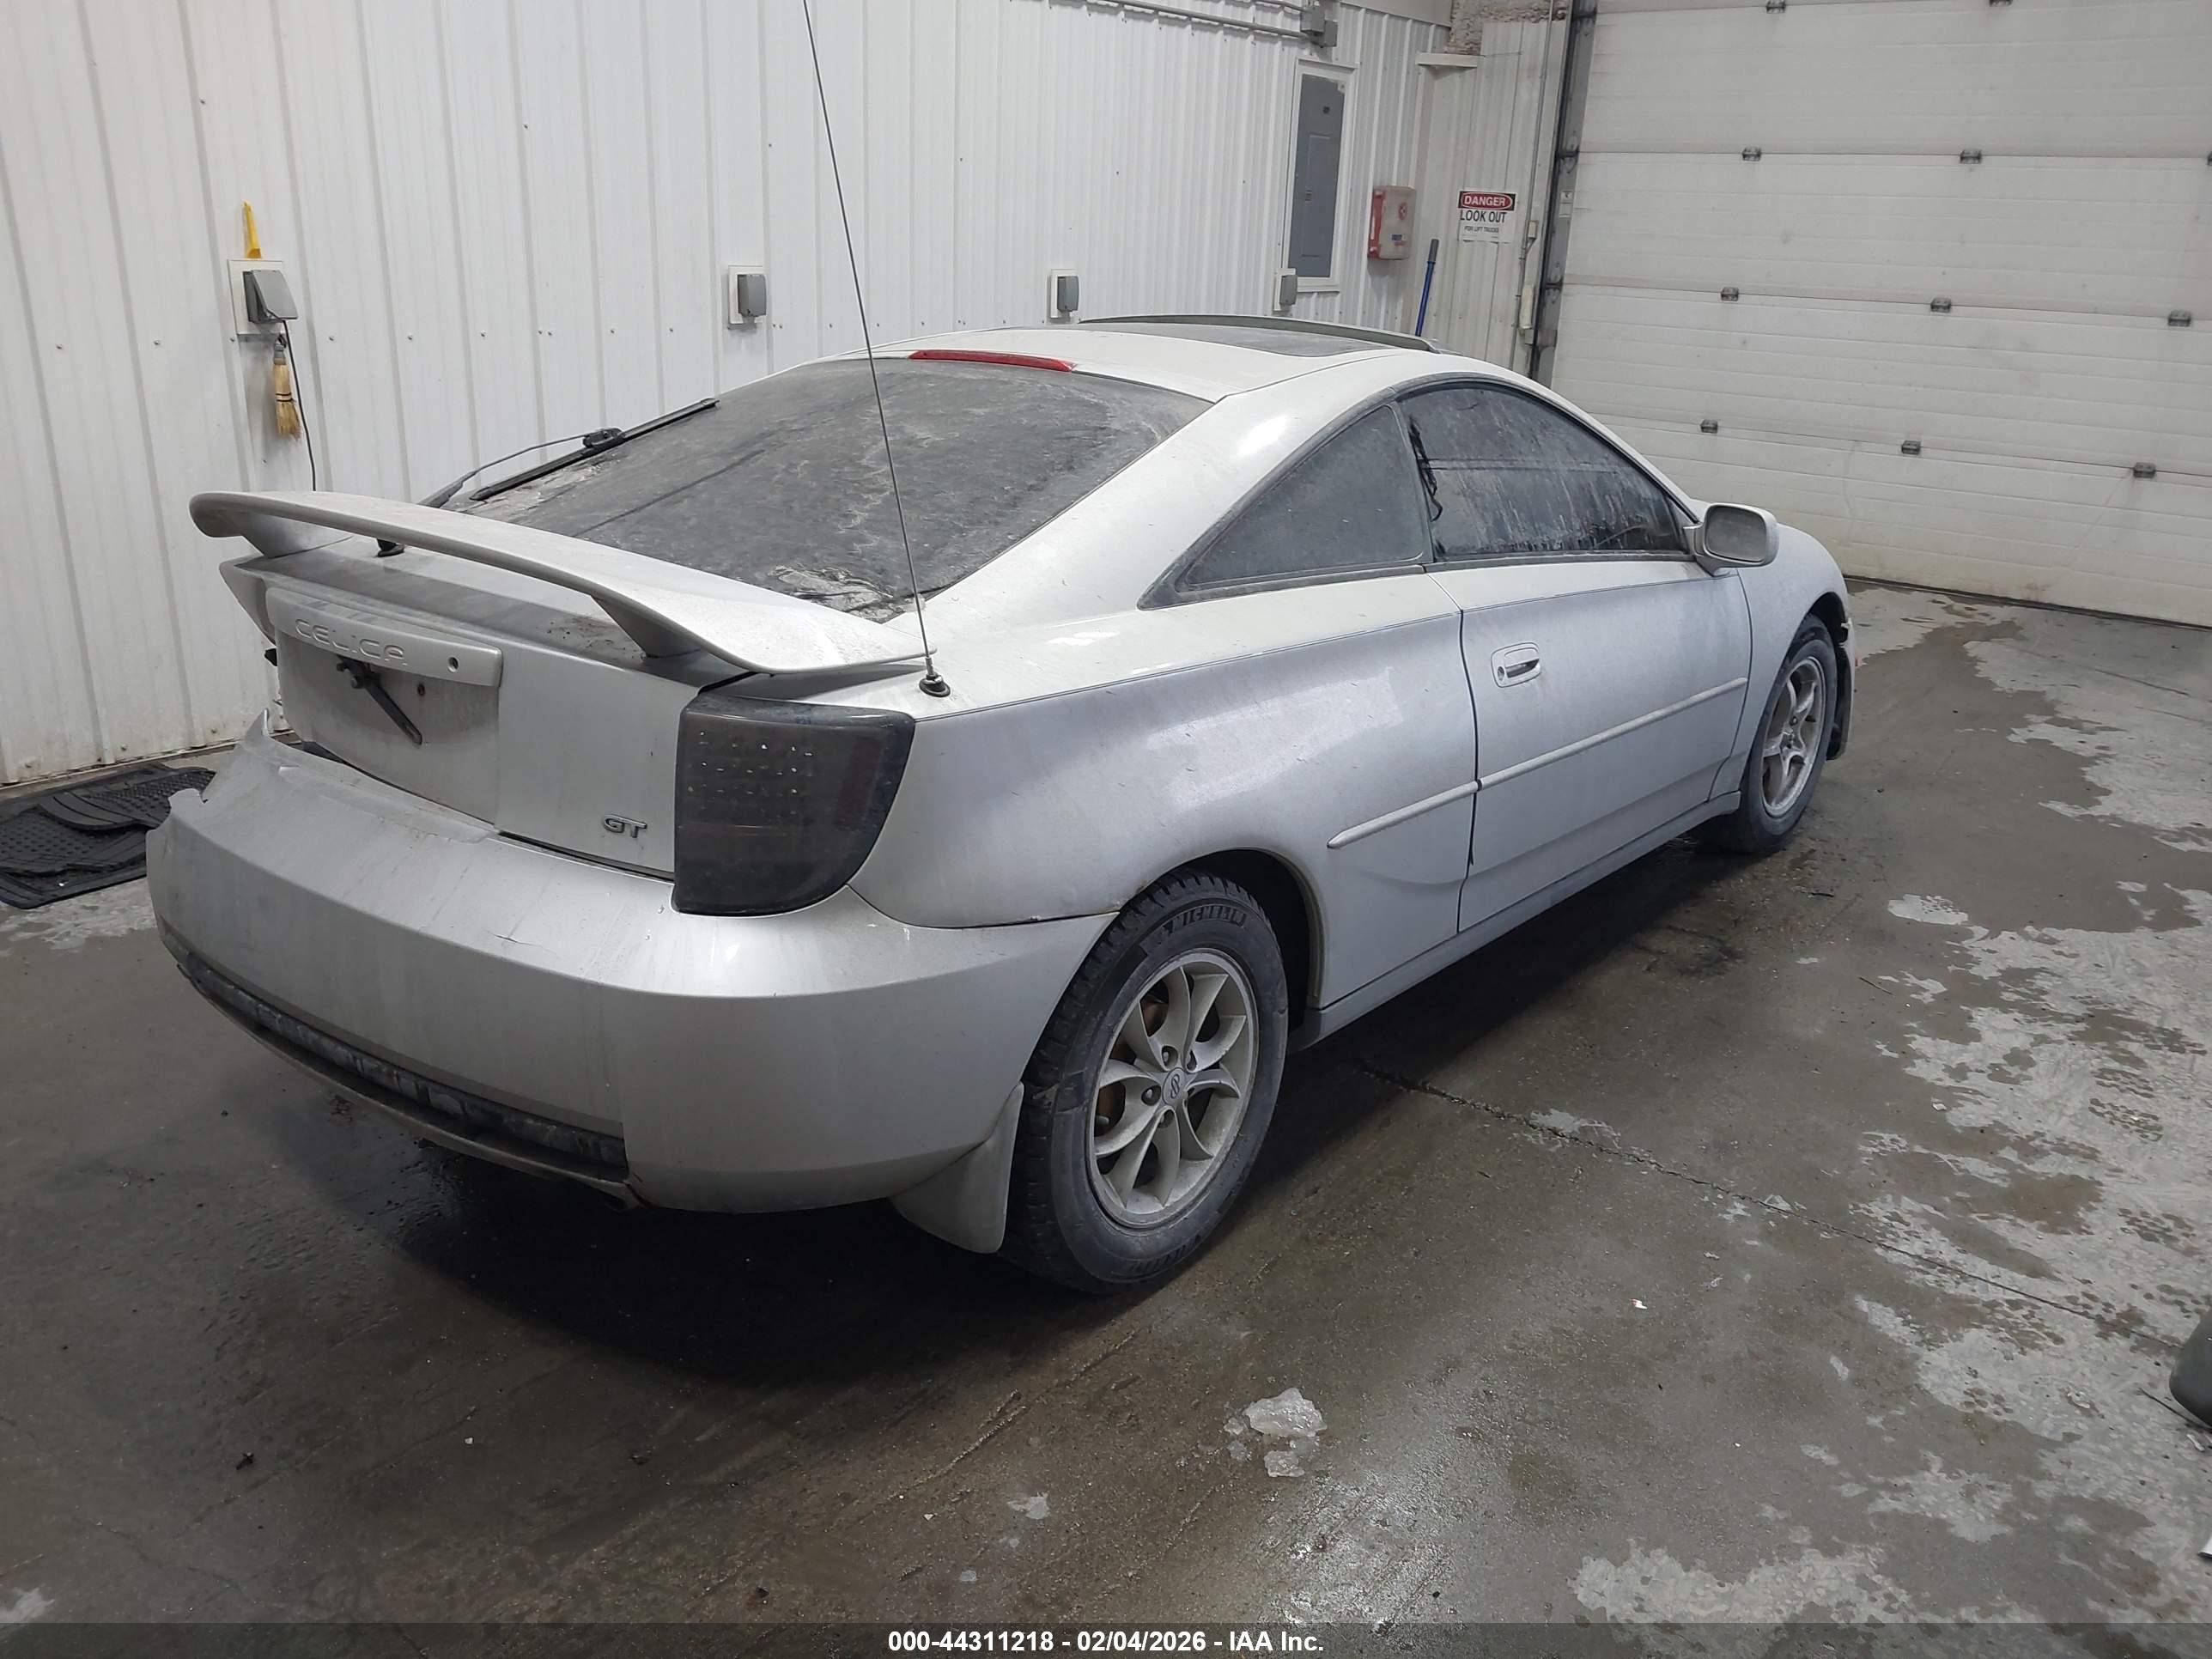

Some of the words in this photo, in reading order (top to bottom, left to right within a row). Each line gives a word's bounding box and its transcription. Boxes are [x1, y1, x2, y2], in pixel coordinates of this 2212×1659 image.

[1464, 196, 1506, 207] DANGER
[1460, 210, 1486, 222] LOOK
[1488, 211, 1508, 223] OUT
[295, 618, 409, 666] CELICA
[604, 814, 647, 838] GT
